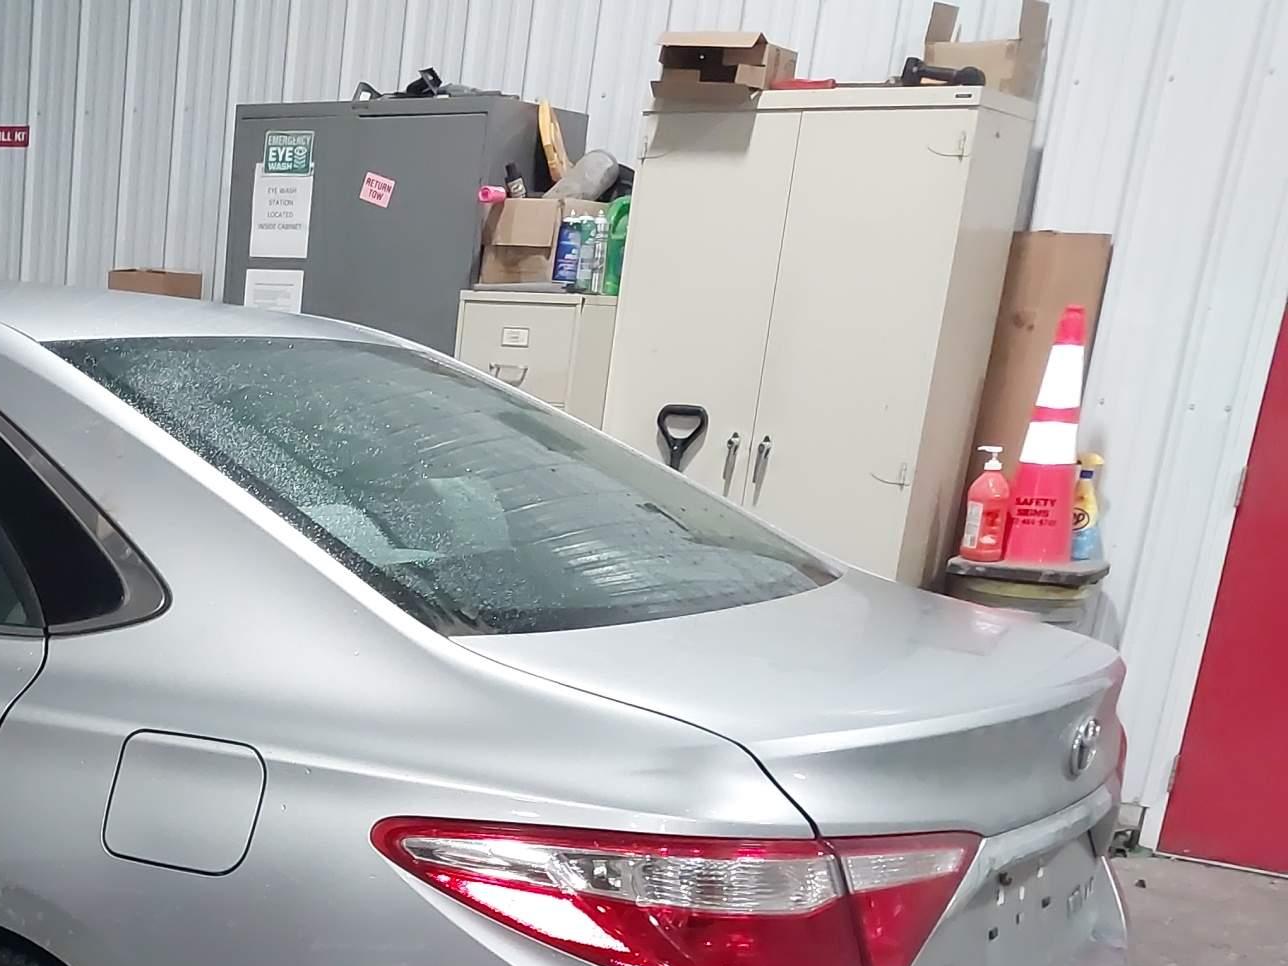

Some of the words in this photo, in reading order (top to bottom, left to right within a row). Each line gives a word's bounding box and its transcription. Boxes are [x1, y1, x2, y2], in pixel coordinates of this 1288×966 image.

[268, 135, 312, 146] EMERGENCY
[268, 146, 294, 162] EYE
[268, 162, 293, 171] WASH
[365, 177, 393, 194] RETURN
[368, 188, 384, 201] TOW
[268, 199, 294, 207] STATION
[267, 211, 294, 219] LOCATED
[1015, 497, 1057, 507] SAFETY
